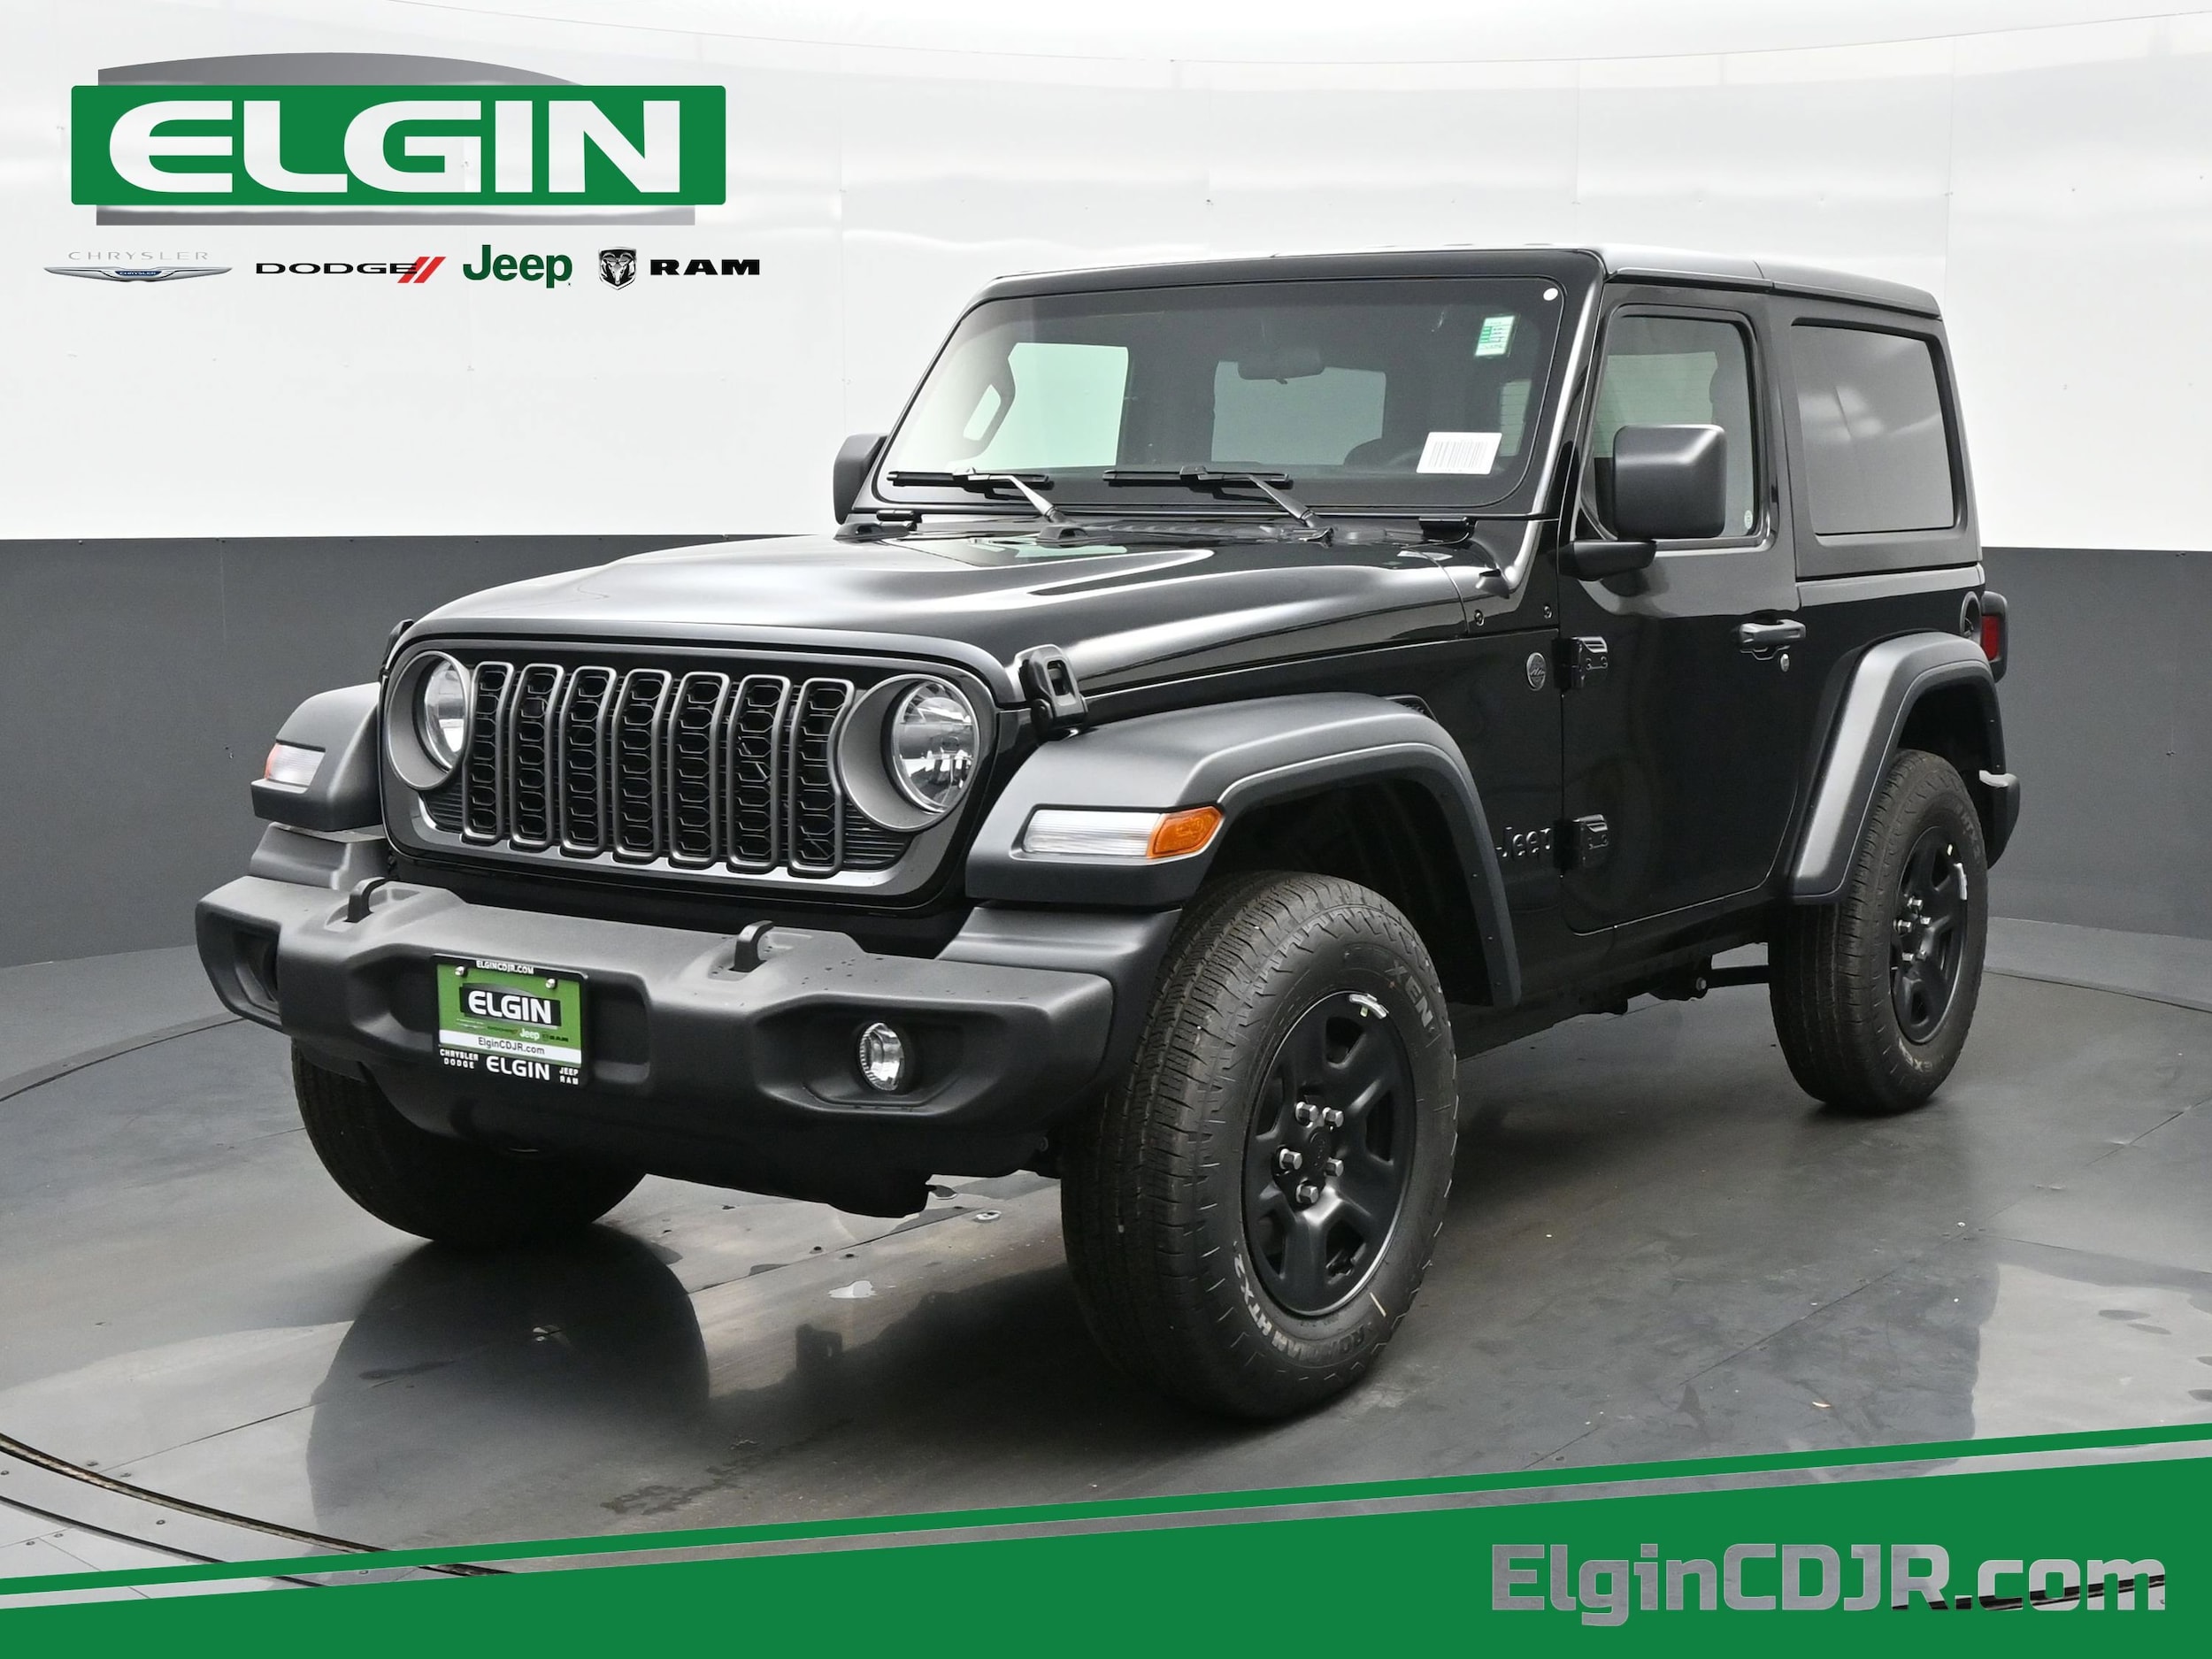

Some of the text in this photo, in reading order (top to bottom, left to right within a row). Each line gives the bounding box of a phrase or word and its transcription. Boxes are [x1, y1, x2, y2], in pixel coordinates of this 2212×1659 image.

[476, 960, 534, 974] ELGINCDJR.COM
[1384, 959, 1434, 1028] XEN
[468, 990, 552, 1024] ELGIN
[519, 1028, 540, 1041] Jeep
[478, 1037, 545, 1055] ElginCDJR.com
[440, 1048, 479, 1062] CHRYSLER
[443, 1057, 475, 1069] DODGE
[487, 1056, 549, 1080] ELGIN
[559, 1066, 579, 1076] JEEP
[559, 1075, 579, 1085] RAM
